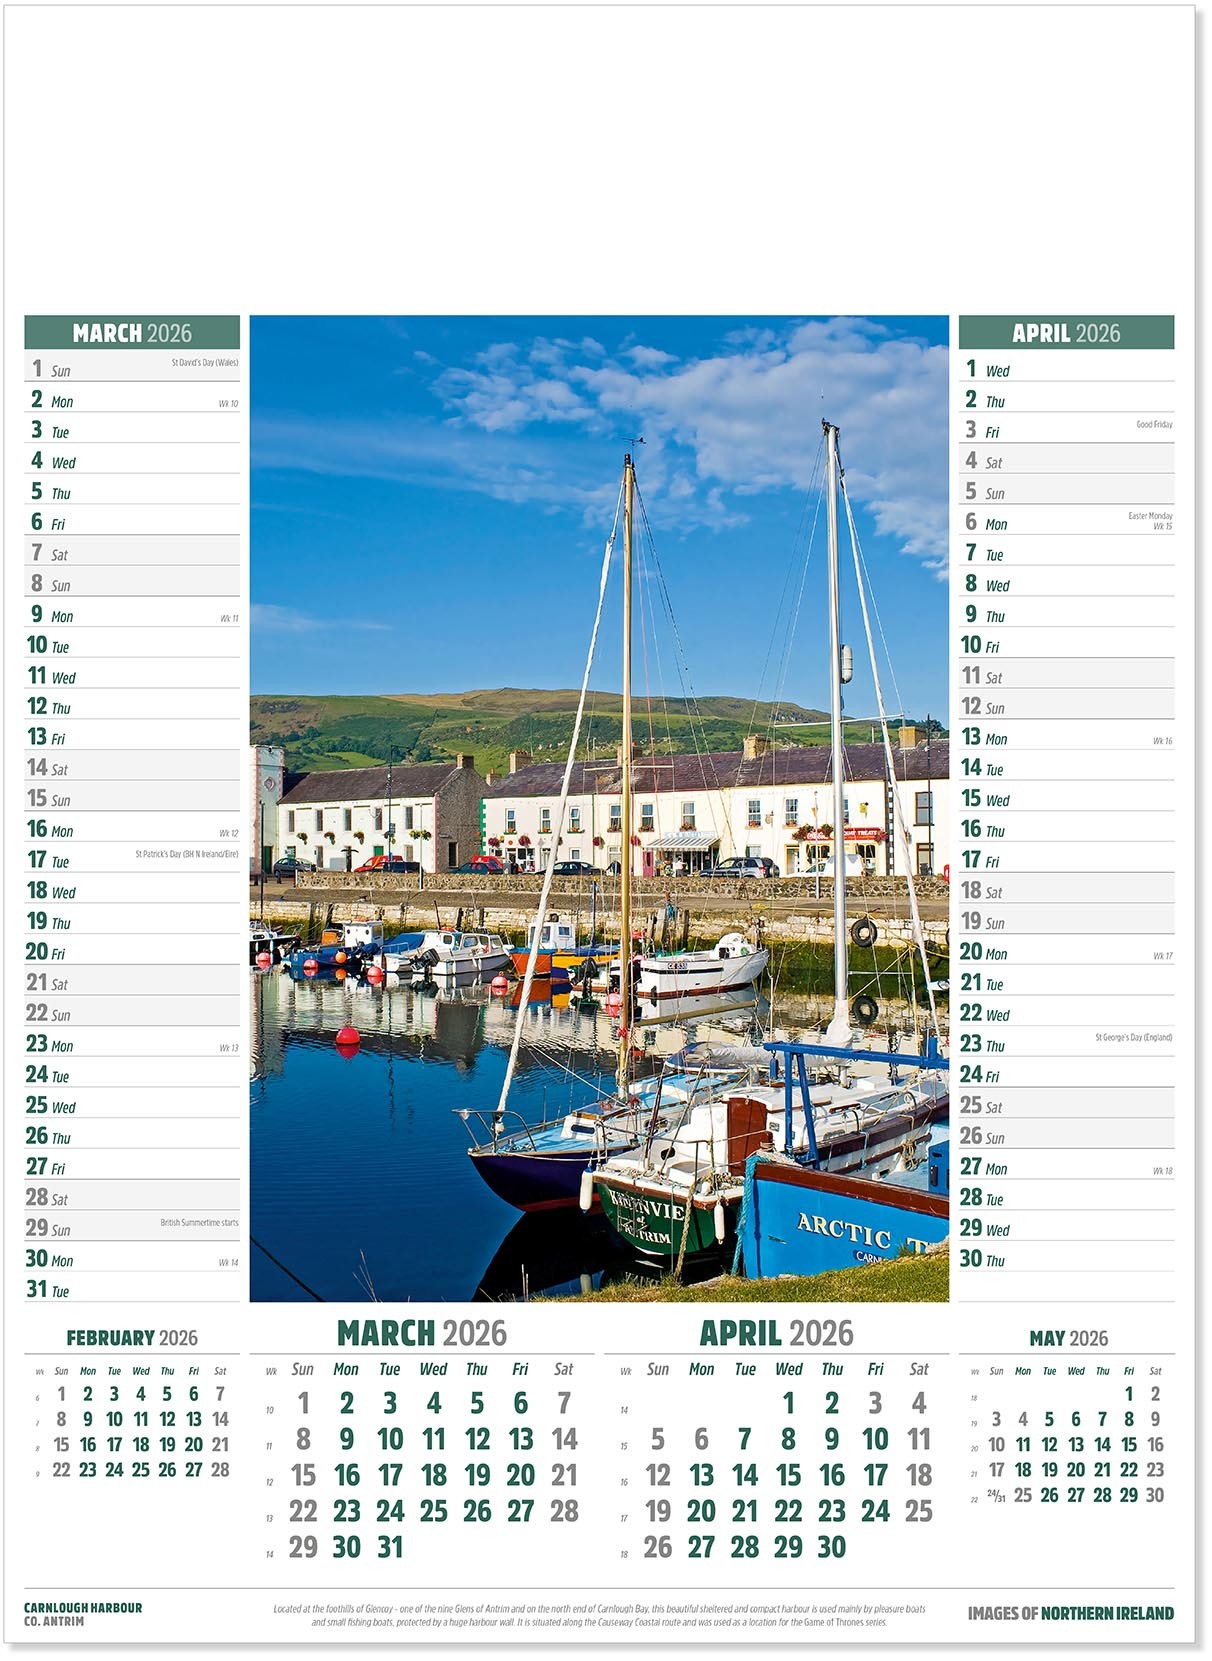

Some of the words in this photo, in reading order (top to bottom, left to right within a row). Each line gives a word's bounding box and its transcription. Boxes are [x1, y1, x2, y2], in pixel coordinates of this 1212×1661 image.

[74, 324, 142, 343] MARCH
[148, 324, 192, 343] 2026
[1013, 324, 1071, 343] APRIL
[1076, 324, 1120, 342] 2026
[172, 358, 178, 367] St
[180, 358, 202, 367] David's
[203, 358, 214, 367] Day
[216, 359, 239, 367] (Wales)
[967, 359, 975, 377] 1
[987, 366, 1010, 378] Wed
[32, 390, 42, 408] 2
[52, 396, 73, 408] Mon
[1137, 420, 1153, 429] Good
[1154, 420, 1173, 429] Friday
[1129, 512, 1148, 520] Easter
[1149, 512, 1173, 521] Monday
[32, 604, 42, 623] 9
[52, 611, 73, 623] Mon
[962, 666, 980, 684] 11
[986, 672, 1003, 684] Sat
[28, 850, 47, 868] 17
[53, 856, 69, 868] Tue
[136, 850, 142, 858] St
[143, 850, 169, 858] Patrick's
[170, 850, 182, 859] Day
[183, 850, 194, 859] (BH
[196, 850, 201, 858] N
[202, 850, 239, 858] Ireland/Eire)
[961, 973, 981, 991] 21
[987, 979, 1003, 991] Tue
[1096, 1033, 1102, 1042] St
[1103, 1033, 1130, 1042] George's
[1131, 1033, 1143, 1042] Day
[1144, 1033, 1173, 1043] (England)
[26, 1065, 49, 1083] 24
[53, 1071, 69, 1083] Tue
[161, 1218, 181, 1227] British
[182, 1218, 220, 1227] Summertime
[797, 1212, 891, 1250] ARCTIC
[960, 1249, 982, 1267] 30
[987, 1255, 1005, 1267] Thu
[27, 1280, 46, 1298] 31
[53, 1286, 69, 1298] Tue
[67, 1330, 155, 1346] FEBRUARY
[160, 1330, 198, 1346] 2026
[338, 1319, 435, 1347] MARCH
[444, 1320, 507, 1346] 2026
[700, 1320, 782, 1346] APRIL
[790, 1320, 854, 1346] 2026
[1030, 1330, 1066, 1346] MAY
[1070, 1330, 1108, 1346] 2026
[292, 1362, 314, 1376] Sun
[334, 1362, 359, 1376] Mon
[380, 1362, 400, 1376] Tue
[420, 1362, 448, 1376] Wed
[467, 1362, 488, 1376] Thu
[512, 1362, 529, 1376] Fri
[554, 1362, 574, 1376] Sat
[53, 1462, 70, 1477] 22
[80, 1462, 96, 1477] 23
[106, 1462, 124, 1477] 24
[132, 1462, 150, 1477] 25
[159, 1462, 176, 1477] 26
[186, 1462, 203, 1477] 27
[212, 1462, 229, 1477] 28
[646, 1500, 671, 1522] 19
[688, 1499, 716, 1522] 20
[732, 1499, 757, 1522] 21
[775, 1499, 802, 1522] 22
[819, 1499, 846, 1522] 23
[862, 1499, 890, 1522] 24
[906, 1500, 932, 1522] 25
[24, 1603, 88, 1613] CARNLOUGH
[91, 1603, 142, 1613] HARBOUR
[274, 1604, 302, 1614] Located
[303, 1605, 311, 1614] at
[312, 1604, 325, 1613] the
[326, 1604, 355, 1614] foothills
[356, 1604, 365, 1613] of
[366, 1604, 394, 1614] Glencoy
[400, 1606, 414, 1614] one
[415, 1604, 423, 1613] of
[425, 1604, 437, 1614] the
[438, 1605, 454, 1614] nine
[455, 1604, 475, 1614] Glens
[476, 1604, 484, 1613] of
[485, 1604, 510, 1613] Antrim
[511, 1604, 526, 1613] and
[538, 1605, 550, 1613] the
[551, 1604, 571, 1614] north
[573, 1604, 587, 1614] end
[588, 1604, 597, 1613] of
[598, 1604, 634, 1614] Carnlough
[635, 1604, 650, 1614] Bay,
[652, 1604, 665, 1613] this
[666, 1604, 699, 1614] beautiful
[700, 1604, 733, 1614] sheltered
[734, 1604, 749, 1613] and
[750, 1605, 781, 1614] compact
[782, 1604, 810, 1614] harbour
[812, 1605, 818, 1613] is
[819, 1604, 838, 1613] used
[838, 1604, 863, 1615] mainly
[864, 1604, 873, 1614] by
[874, 1604, 905, 1614] pleasure
[906, 1605, 926, 1614] boats
[969, 1607, 1019, 1620] IMAGES
[1022, 1607, 1038, 1620] OF
[1042, 1606, 1114, 1620] NORTHERN
[1116, 1606, 1174, 1620] IRELAND
[24, 1616, 41, 1626] CO.
[43, 1616, 84, 1626] ANTRIM
[312, 1618, 326, 1627] and
[327, 1618, 347, 1627] small
[348, 1618, 372, 1628] fishing
[373, 1618, 395, 1627] boats,
[396, 1618, 432, 1628] protected
[432, 1618, 442, 1628] by
[449, 1618, 468, 1628] huge
[469, 1618, 498, 1627] harbour
[500, 1618, 515, 1626] wall.
[517, 1618, 523, 1627] It
[525, 1618, 530, 1627] is
[532, 1618, 562, 1627] situated
[562, 1618, 583, 1628] along
[585, 1618, 597, 1627] the
[598, 1618, 634, 1628] Causeway
[635, 1618, 661, 1627] Coastal
[662, 1619, 682, 1627] route
[682, 1619, 697, 1627] and
[698, 1619, 712, 1627] was
[714, 1618, 732, 1627] used
[749, 1618, 777, 1627] location
[779, 1618, 789, 1627] for
[791, 1618, 803, 1626] the
[804, 1618, 825, 1626] Game
[826, 1618, 834, 1626] of
[836, 1618, 864, 1627] Thrones
[866, 1618, 887, 1627] series.
